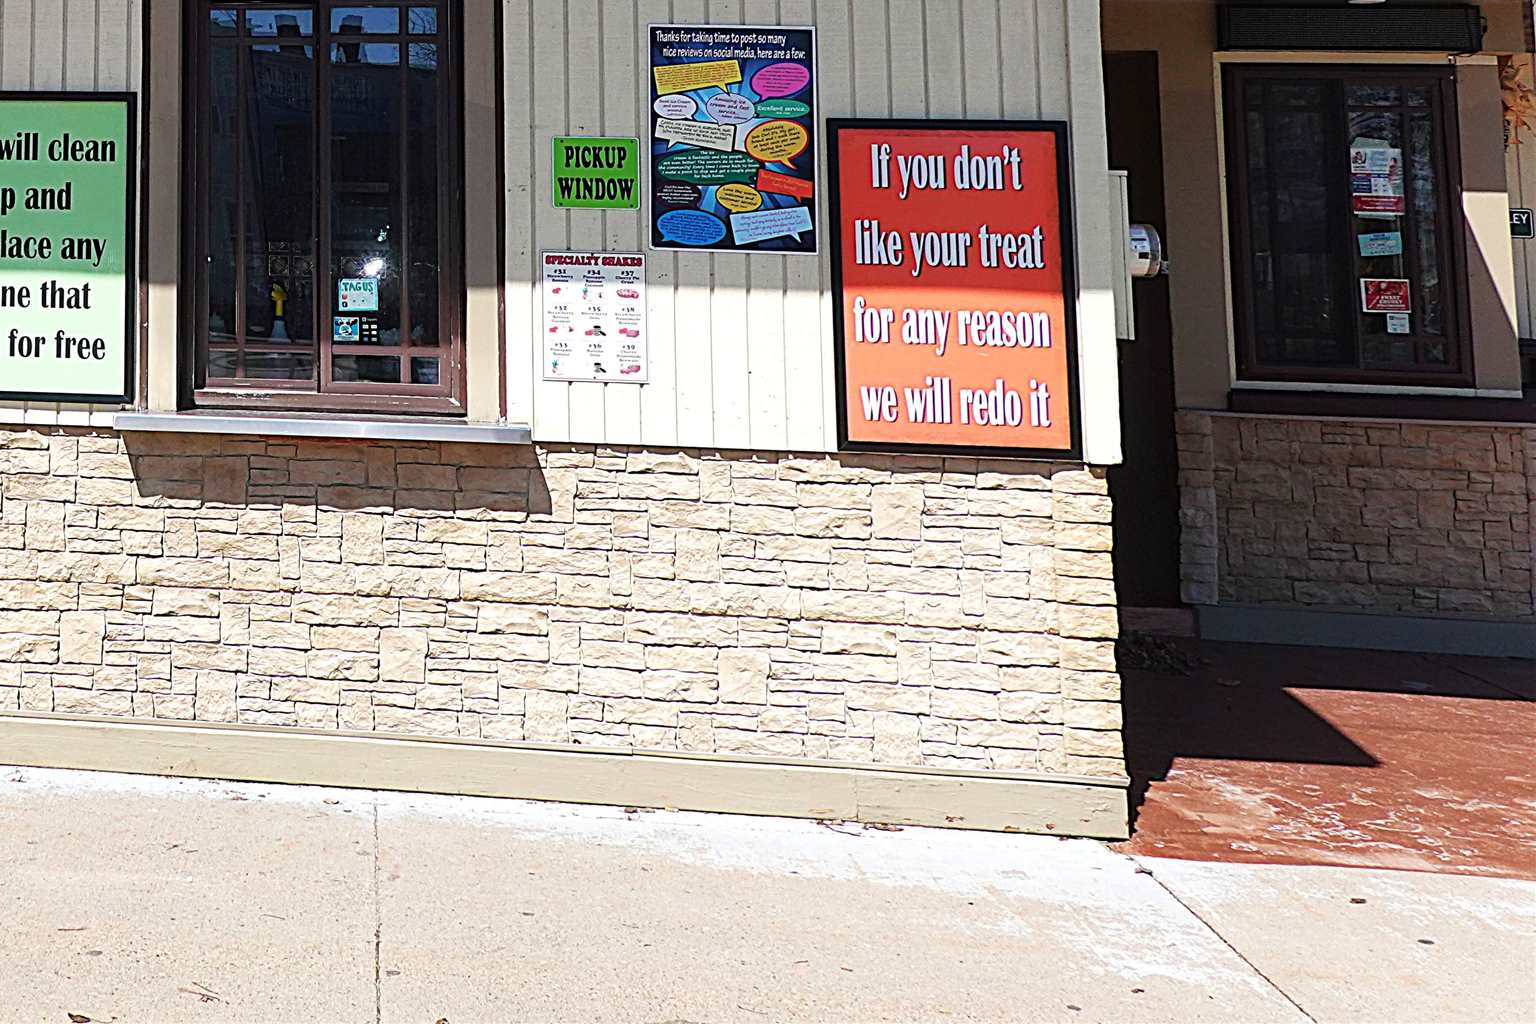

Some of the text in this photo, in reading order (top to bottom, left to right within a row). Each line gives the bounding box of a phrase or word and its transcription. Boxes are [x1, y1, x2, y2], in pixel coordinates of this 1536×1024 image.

[656, 30, 786, 47] Thanks for taking time to post so many
[663, 46, 676, 56] nice
[678, 47, 703, 57] reviews
[704, 49, 712, 57] on
[713, 47, 733, 57] social
[734, 47, 756, 59] media,
[757, 47, 772, 58] here
[773, 50, 785, 59] are
[48, 132, 116, 162] clean
[564, 145, 626, 169] PICKUP
[870, 143, 891, 188] If
[897, 154, 945, 199] you
[24, 182, 72, 210] and
[558, 177, 634, 200] WINDOW
[1509, 214, 1528, 224] EY
[61, 236, 106, 267] any
[545, 255, 642, 266] SPECIALTY SHAKES
[854, 218, 904, 266] like
[910, 229, 971, 277] your
[978, 225, 1045, 269] treat
[40, 280, 91, 310] that
[853, 296, 1051, 356] for any reason
[8, 329, 46, 358] for
[54, 330, 106, 360] free
[860, 375, 1052, 428] we will redo it
